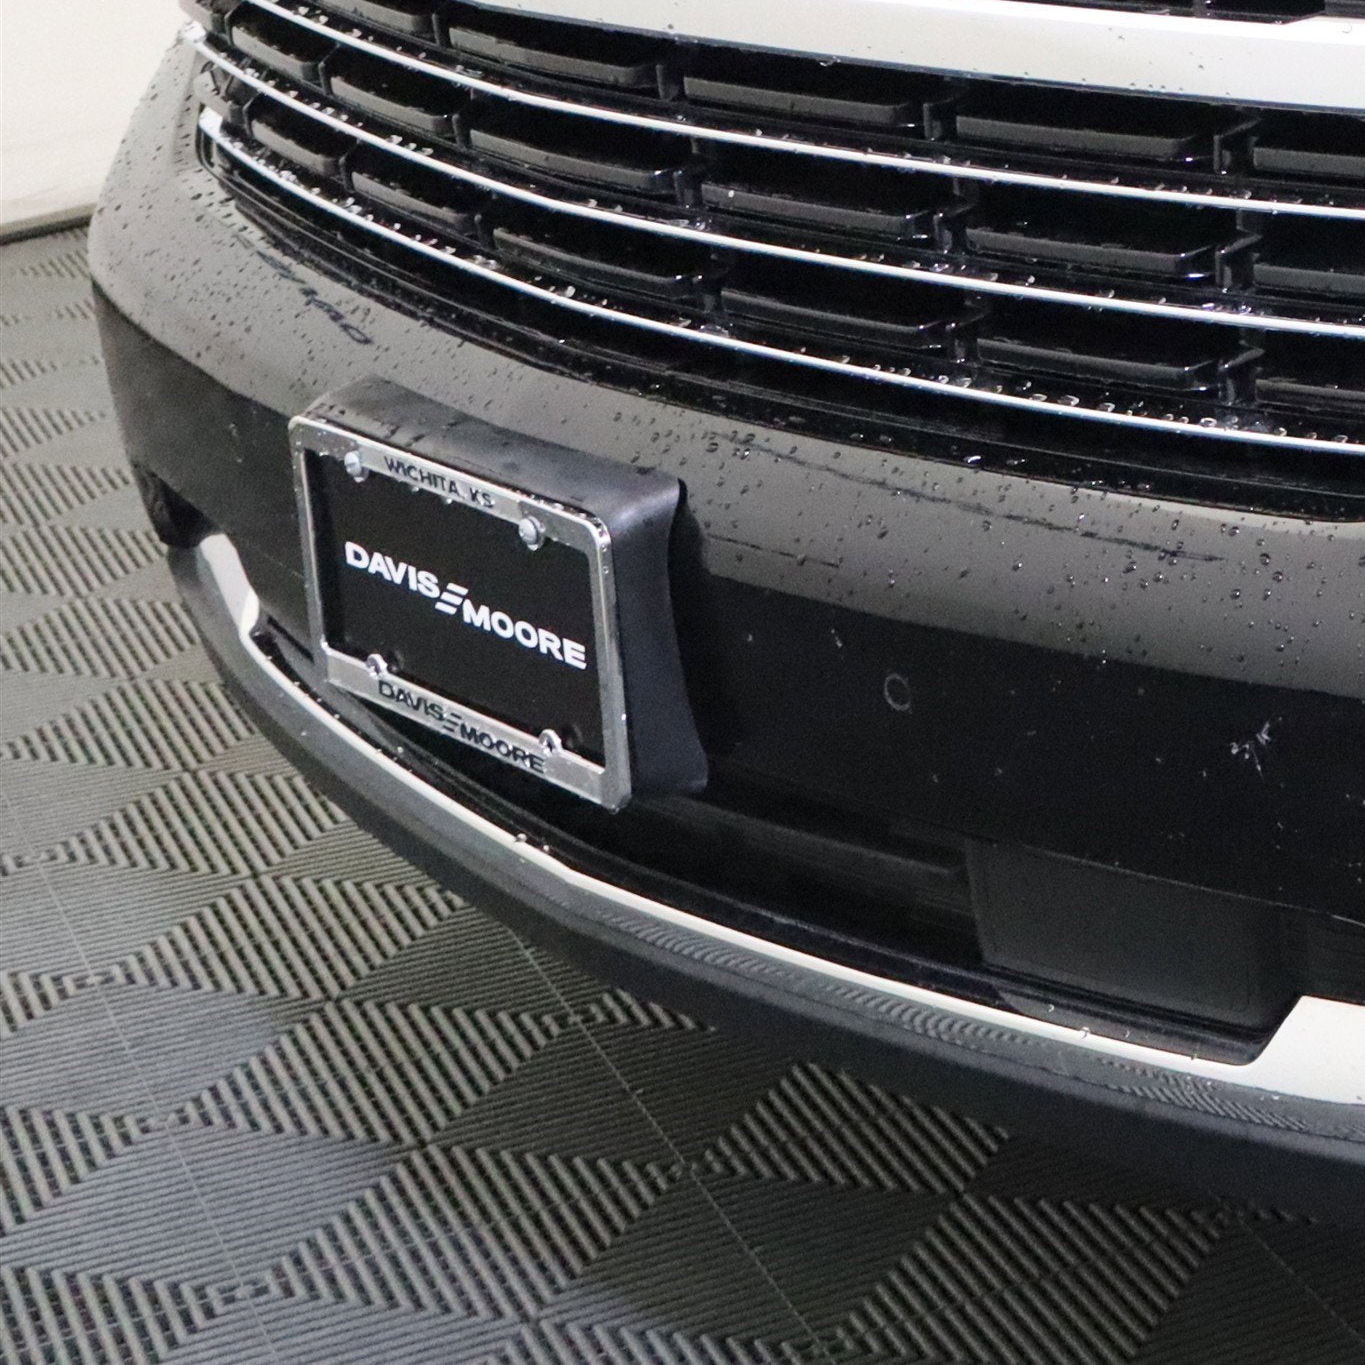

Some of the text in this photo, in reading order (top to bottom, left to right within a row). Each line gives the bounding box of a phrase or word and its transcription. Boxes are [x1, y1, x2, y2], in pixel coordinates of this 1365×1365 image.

[469, 486, 496, 509] KS
[345, 541, 587, 671] DAVIS MOORE
[378, 679, 546, 775] DAVIS MOORE
